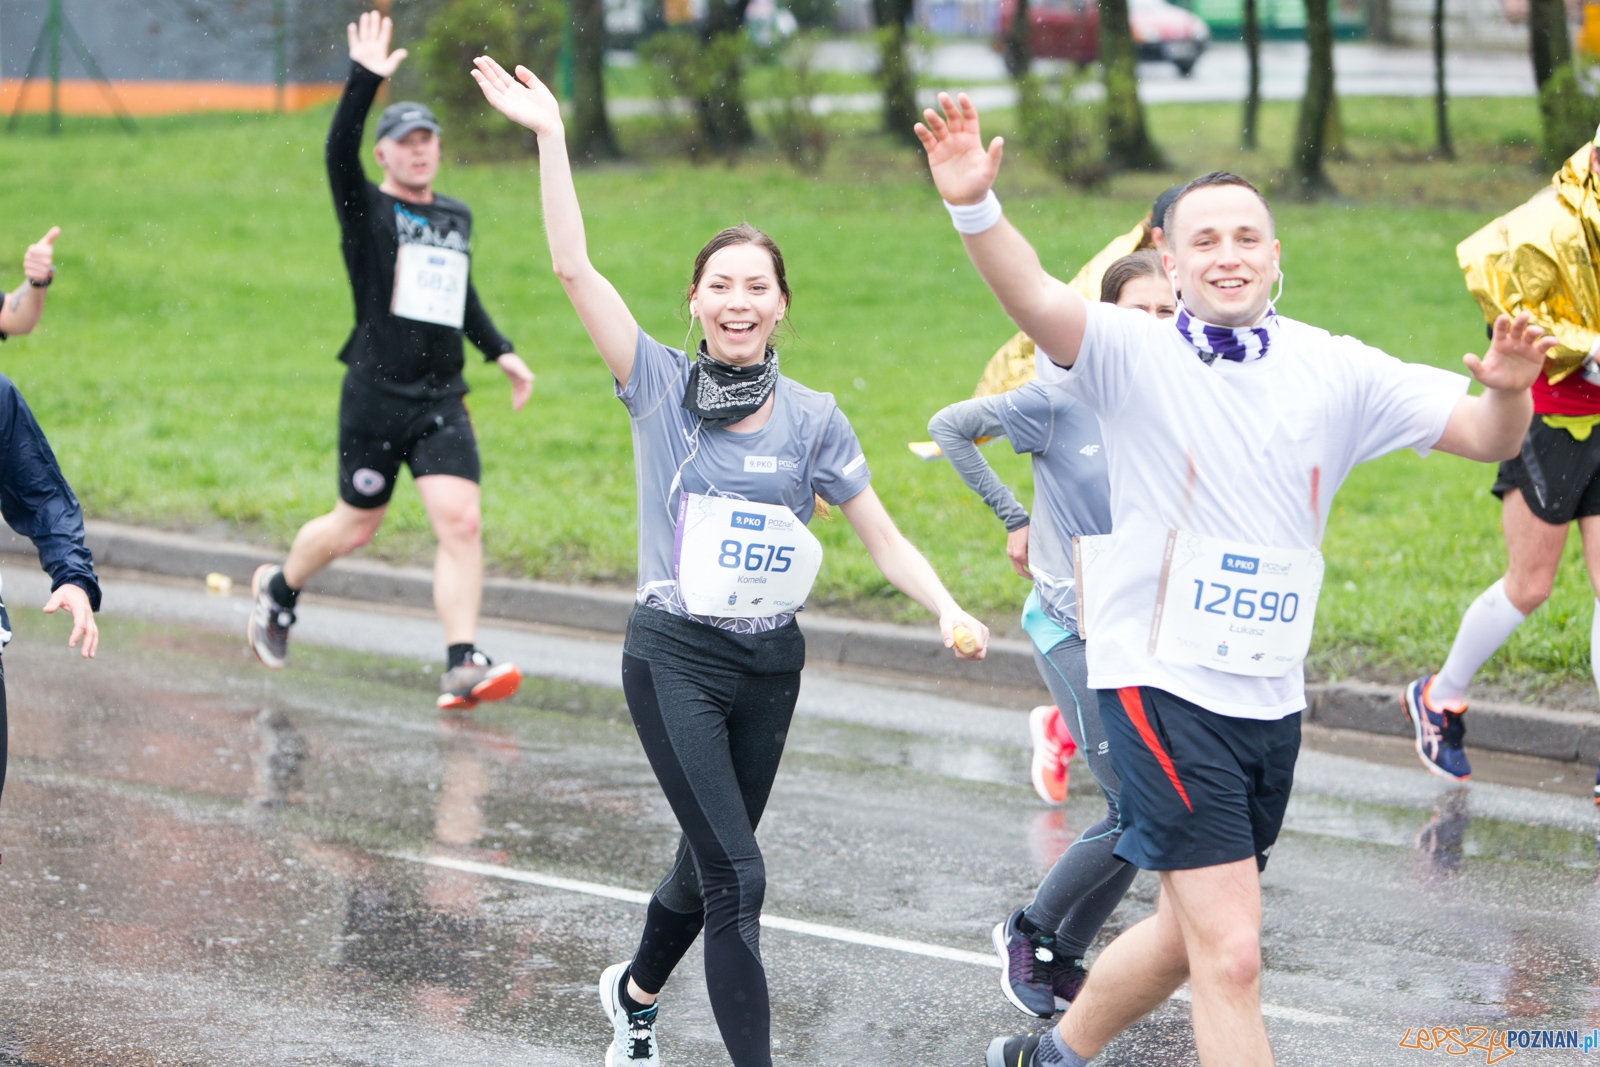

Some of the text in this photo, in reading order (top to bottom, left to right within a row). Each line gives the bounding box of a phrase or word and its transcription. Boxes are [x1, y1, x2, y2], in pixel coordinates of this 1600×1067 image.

[1079, 444, 1101, 457] 4F
[743, 516, 761, 527] PKO
[718, 539, 795, 573] 8615
[1235, 559, 1254, 570] PKO
[1193, 578, 1299, 623] 12690
[1229, 623, 1264, 636] Łukasz
